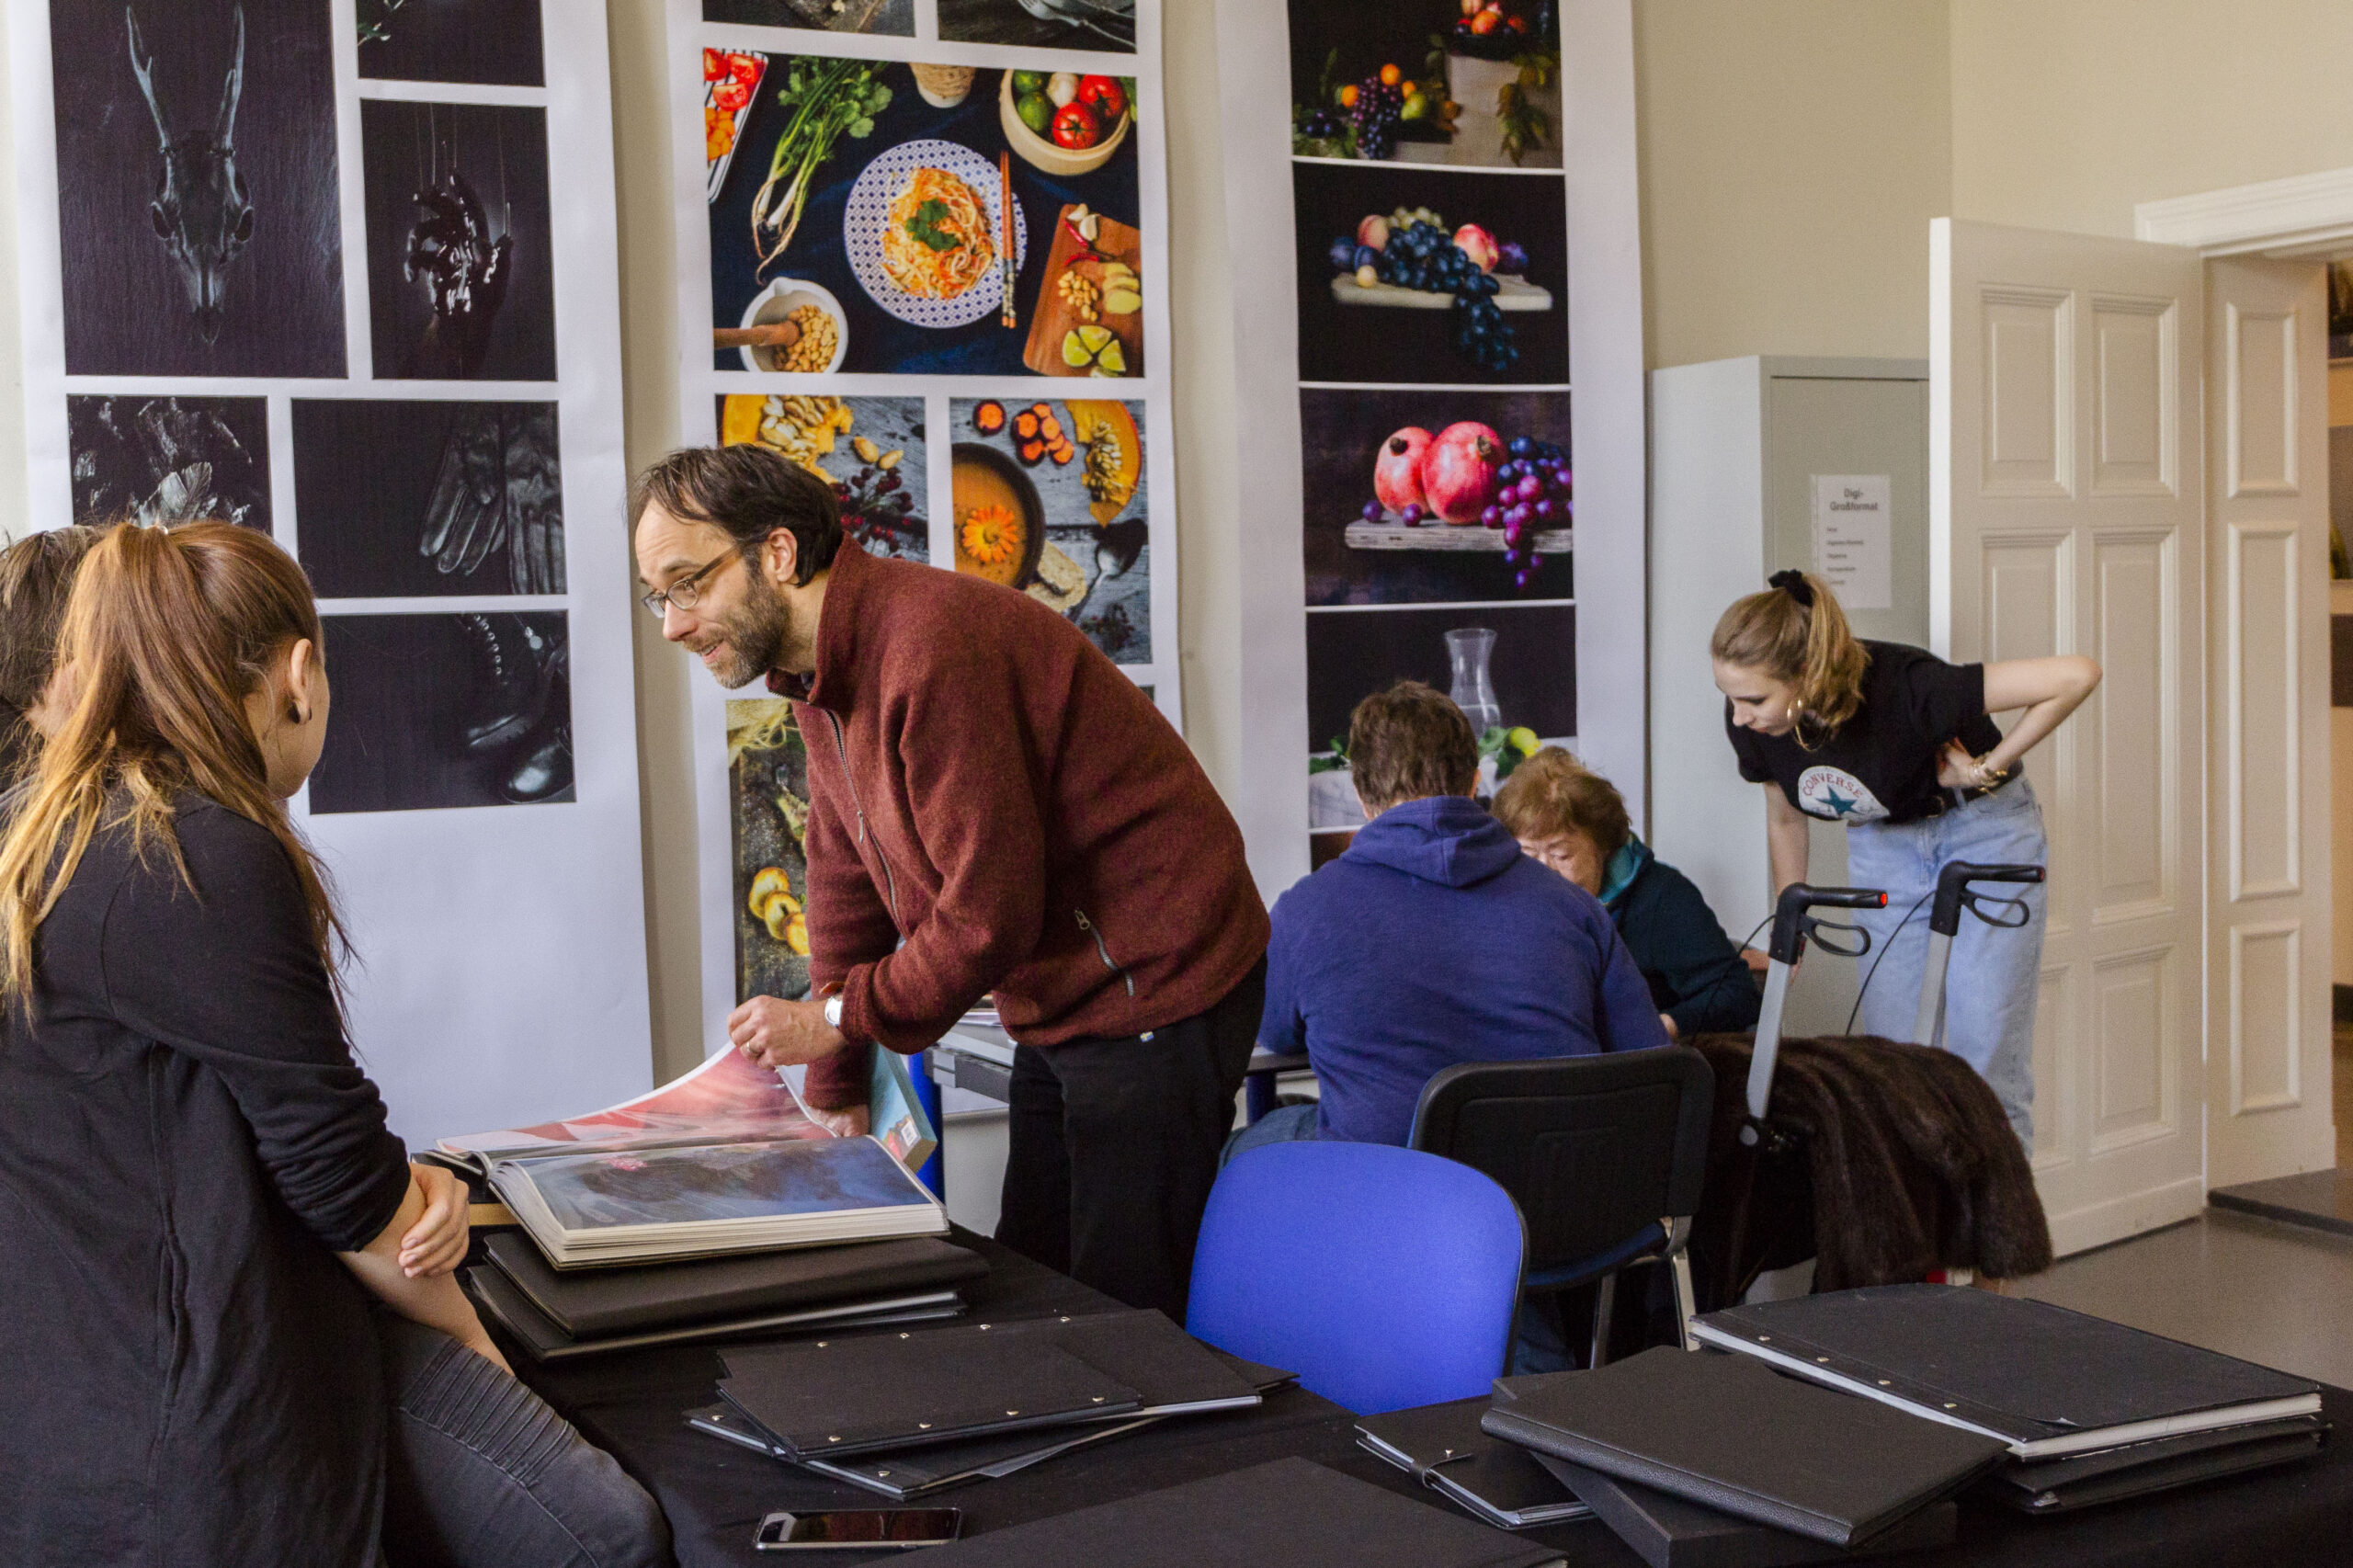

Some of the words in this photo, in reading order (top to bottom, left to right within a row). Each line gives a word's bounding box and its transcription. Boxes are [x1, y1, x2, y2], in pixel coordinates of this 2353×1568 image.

[1844, 487, 1864, 499] Digi-
[1829, 501, 1878, 511] Großformat
[1802, 772, 1864, 798] CONVERSE
